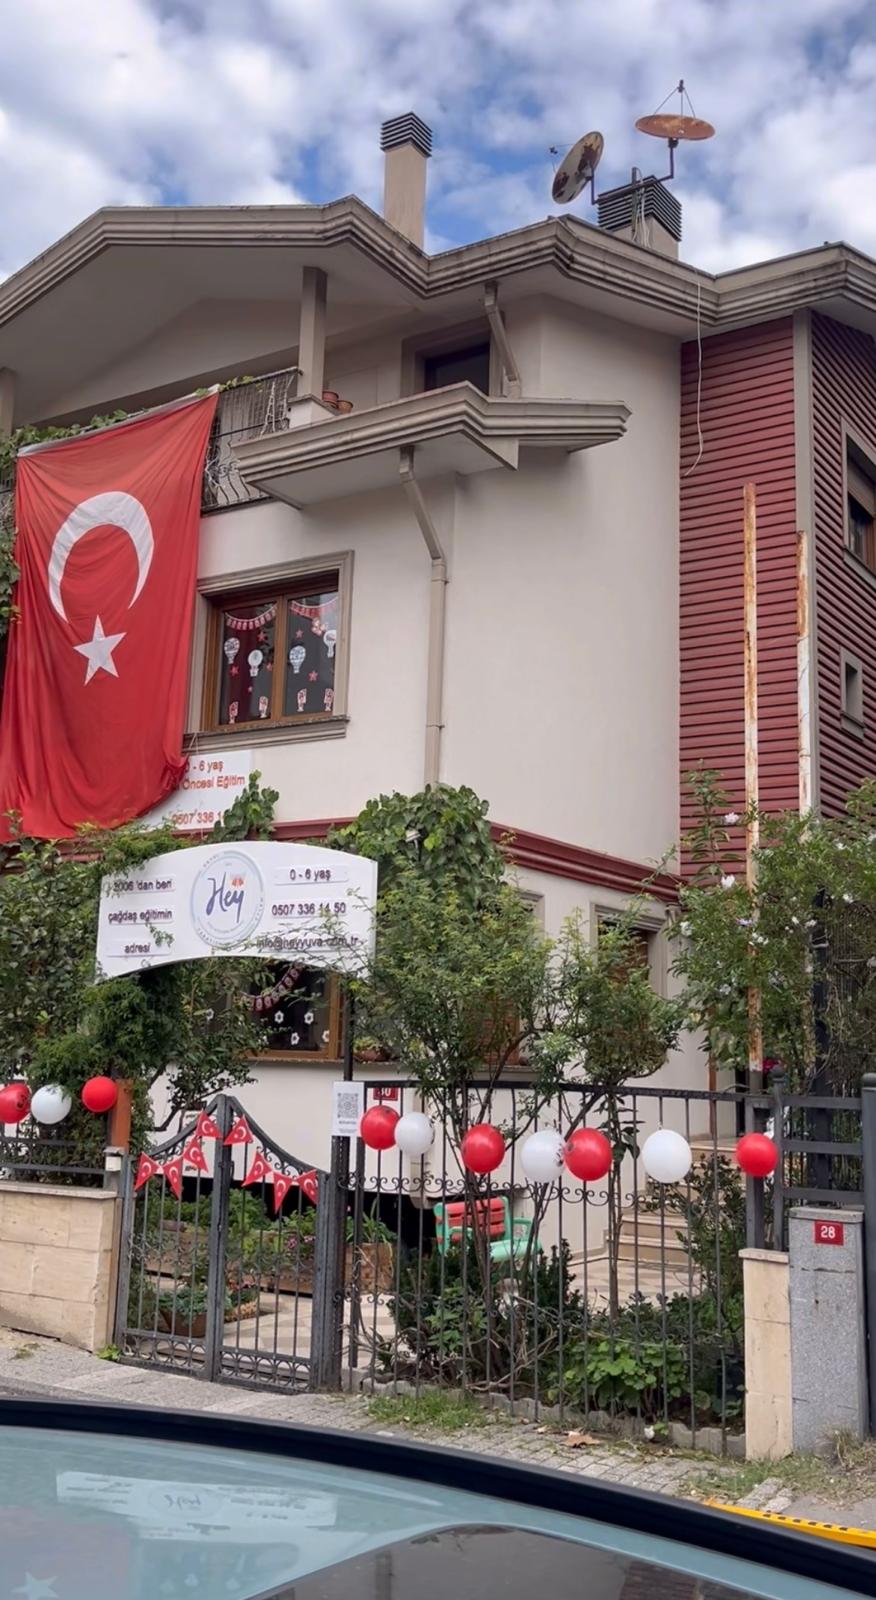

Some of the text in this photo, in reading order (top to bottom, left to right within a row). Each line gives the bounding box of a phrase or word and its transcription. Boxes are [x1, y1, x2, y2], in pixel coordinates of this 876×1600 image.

[199, 760, 205, 771] 6
[207, 760, 224, 773] yaş
[182, 775, 245, 790] Öncesi Eğitim
[197, 811, 214, 823] 336
[290, 869, 296, 880] 0
[305, 868, 311, 880] 6
[314, 869, 331, 882] yaş
[156, 879, 172, 890] beri
[206, 871, 244, 924] Hey
[272, 904, 295, 916] 0507
[297, 903, 315, 915] 336
[334, 902, 346, 914] 50
[108, 909, 172, 925] çağdaş eğitimin
[124, 942, 151, 954] adresi
[820, 1225, 836, 1239] 28
